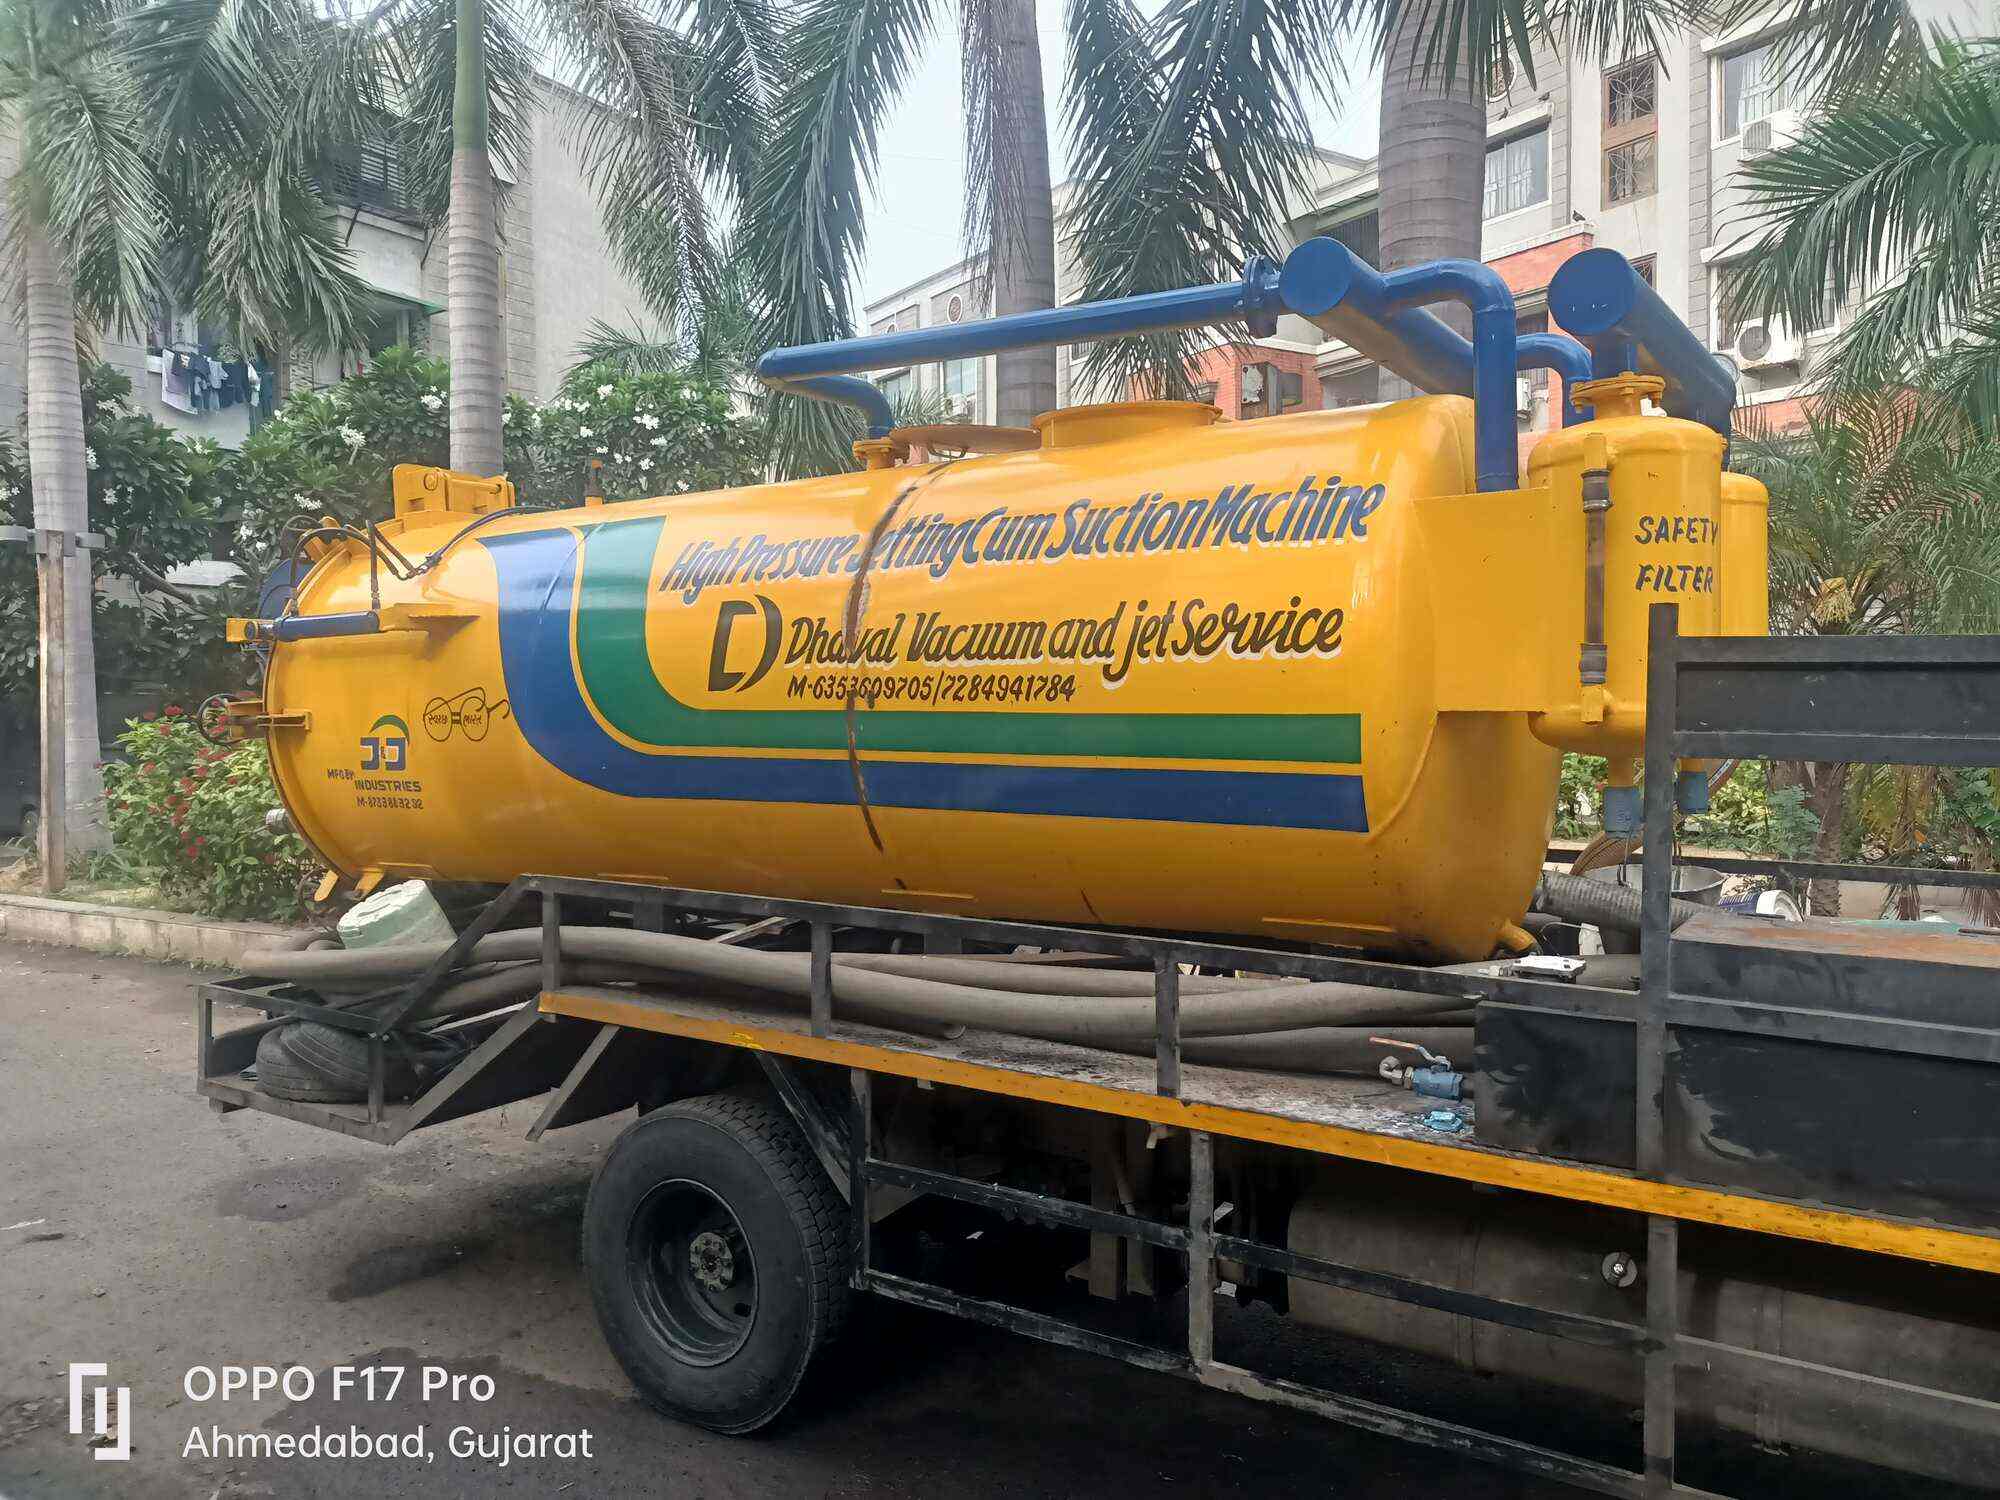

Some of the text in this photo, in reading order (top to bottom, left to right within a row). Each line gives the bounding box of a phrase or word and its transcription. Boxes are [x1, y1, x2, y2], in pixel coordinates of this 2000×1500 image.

[658, 536, 740, 606] High
[741, 533, 861, 585] Pressure
[960, 506, 1057, 564] Cum
[1045, 491, 1209, 559] Suction
[1199, 475, 1387, 549] Machine
[1634, 515, 1720, 546] SAFETY
[1634, 563, 1714, 594] FILTER
[784, 595, 1344, 685] Dhaval Vacuum and jet Service
[355, 779, 422, 793] INDUSTRIES
